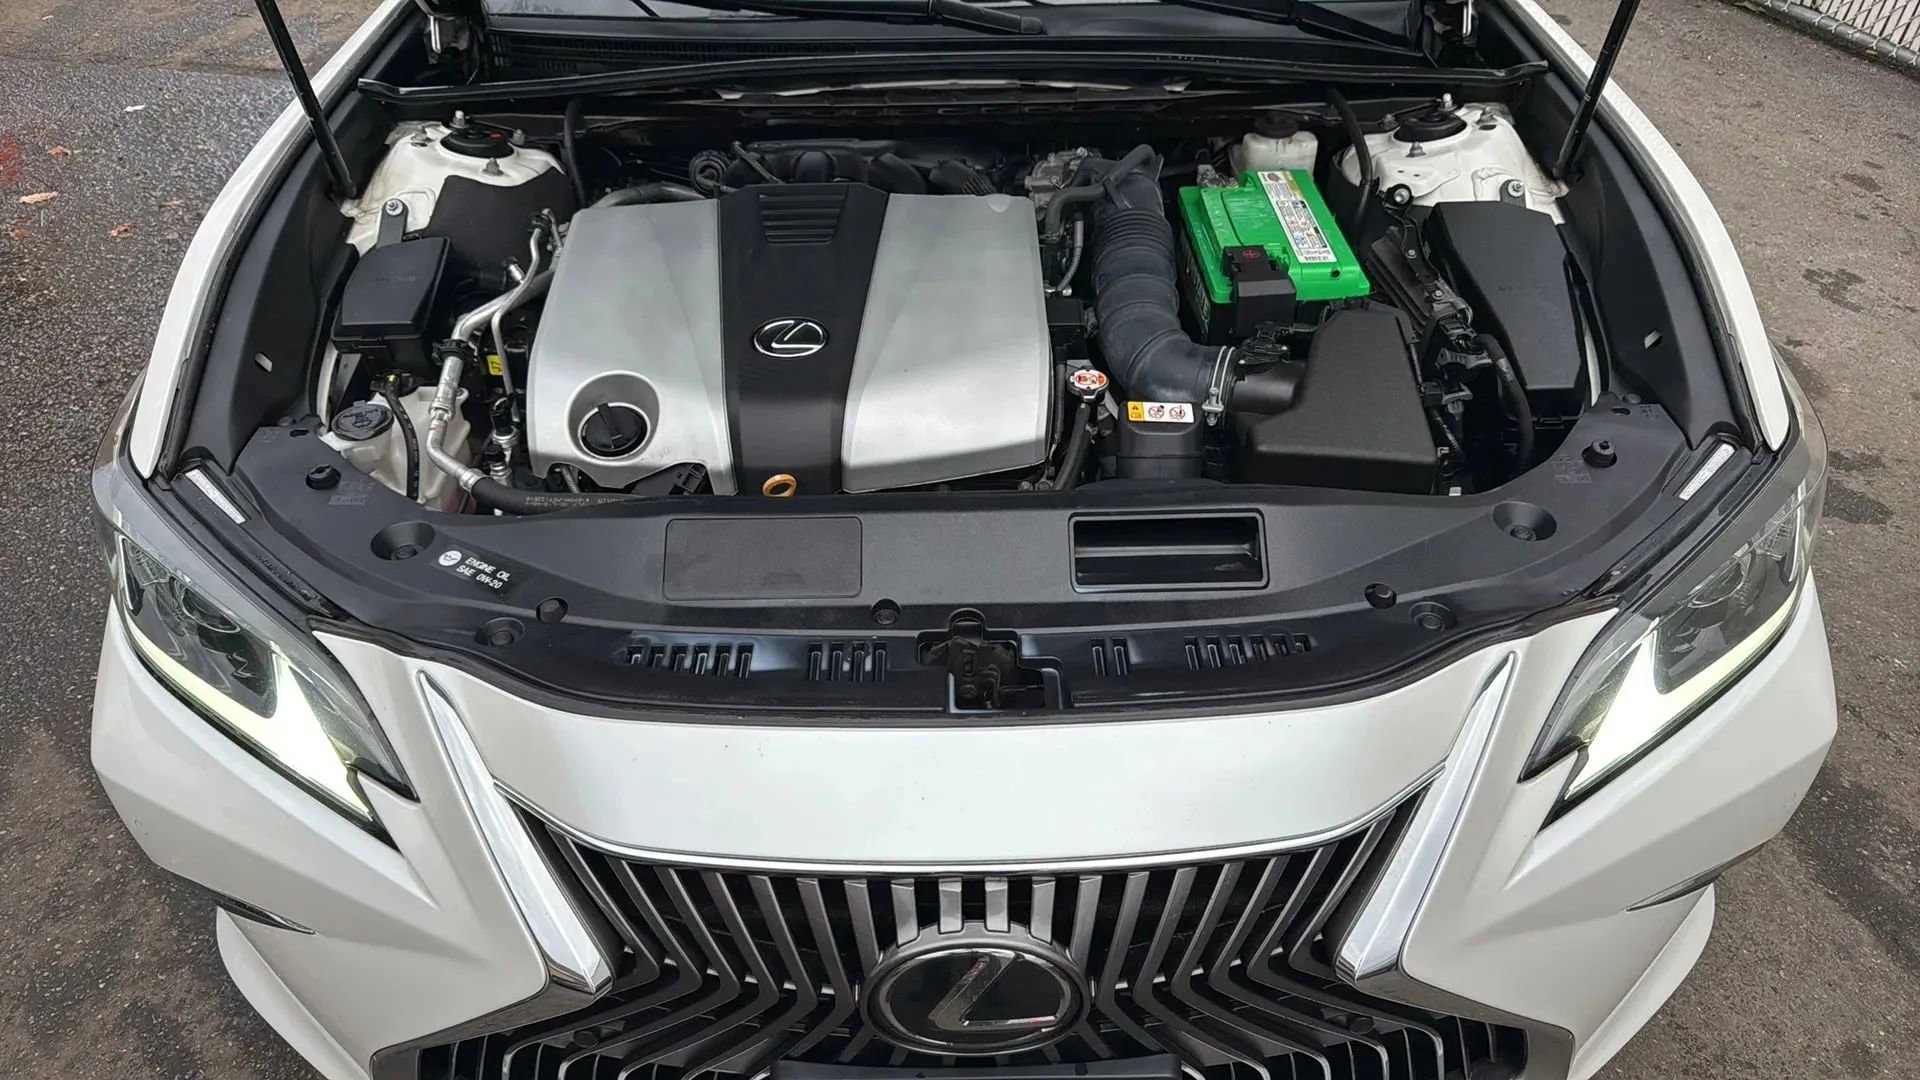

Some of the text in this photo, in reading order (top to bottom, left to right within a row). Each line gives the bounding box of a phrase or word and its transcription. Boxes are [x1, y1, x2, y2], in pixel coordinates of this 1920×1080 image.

[456, 564, 503, 589] SAE 0W-20
[465, 556, 511, 582] ENGINE OIL
